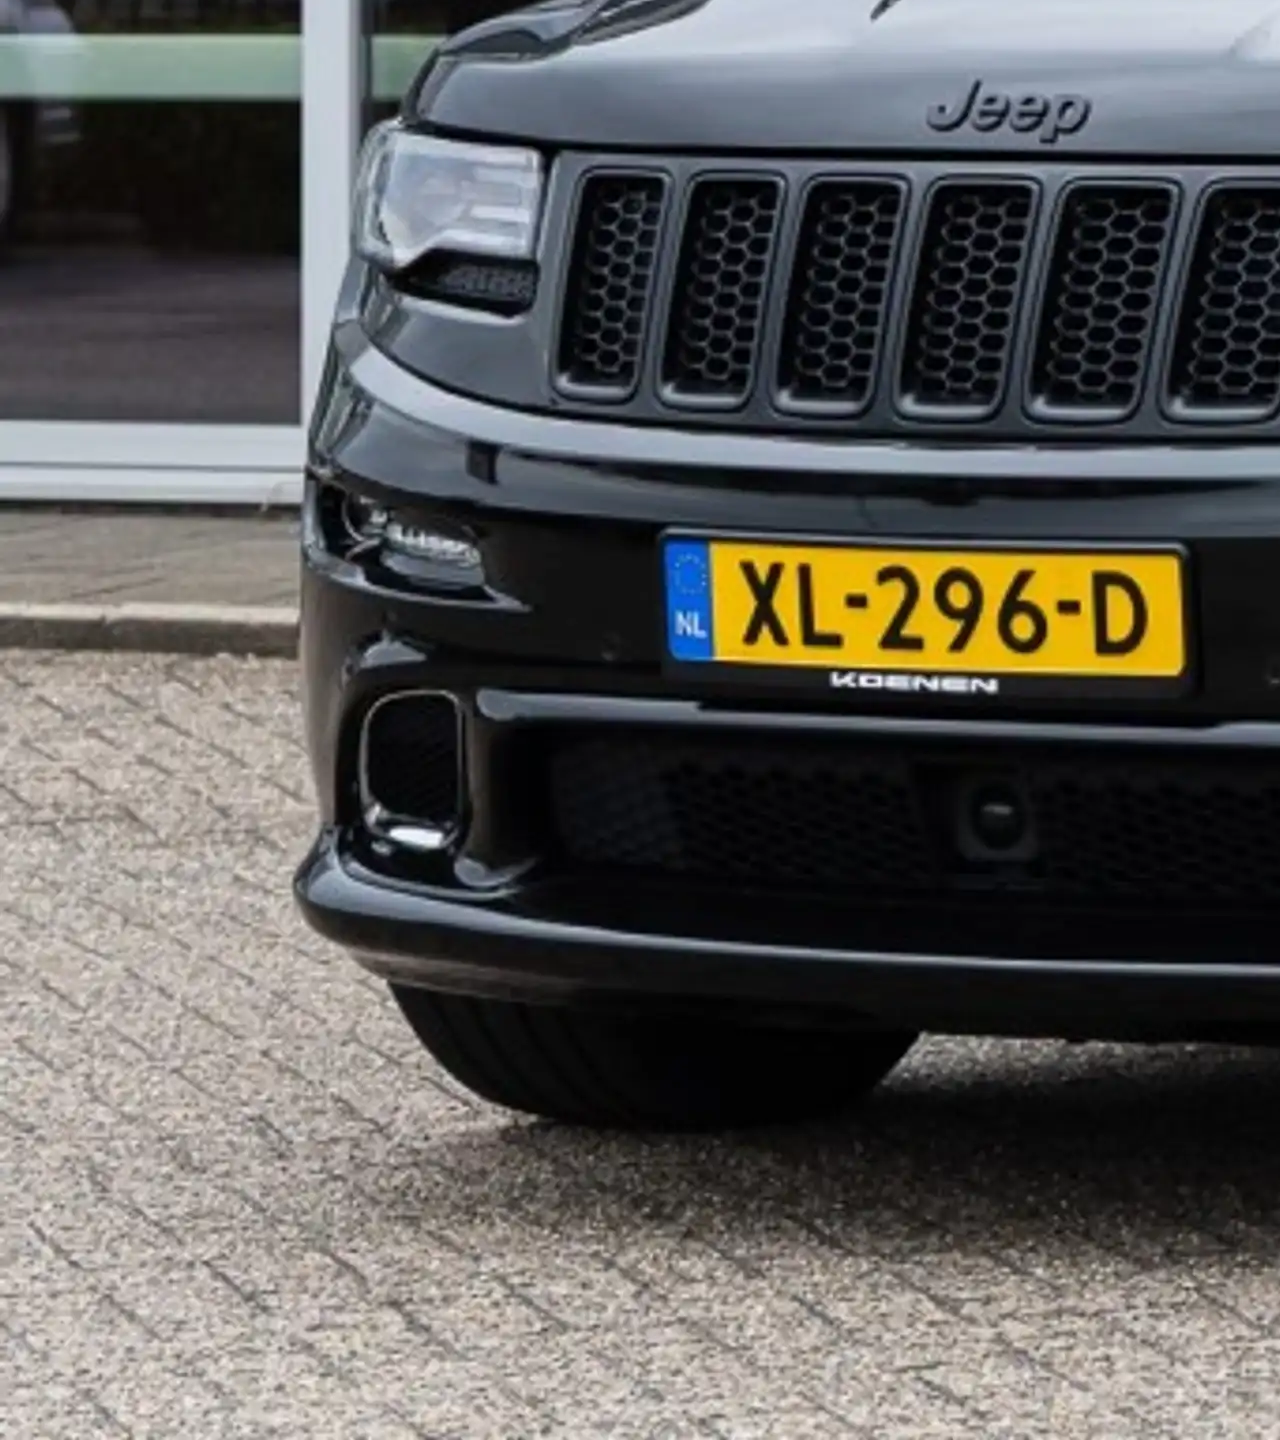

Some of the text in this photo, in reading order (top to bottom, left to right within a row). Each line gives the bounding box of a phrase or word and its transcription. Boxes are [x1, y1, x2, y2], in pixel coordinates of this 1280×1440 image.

[926, 79, 1092, 143] Jeep
[675, 612, 707, 637] NL
[740, 561, 1149, 655] XL-296-D
[829, 671, 999, 693] KOENEN
